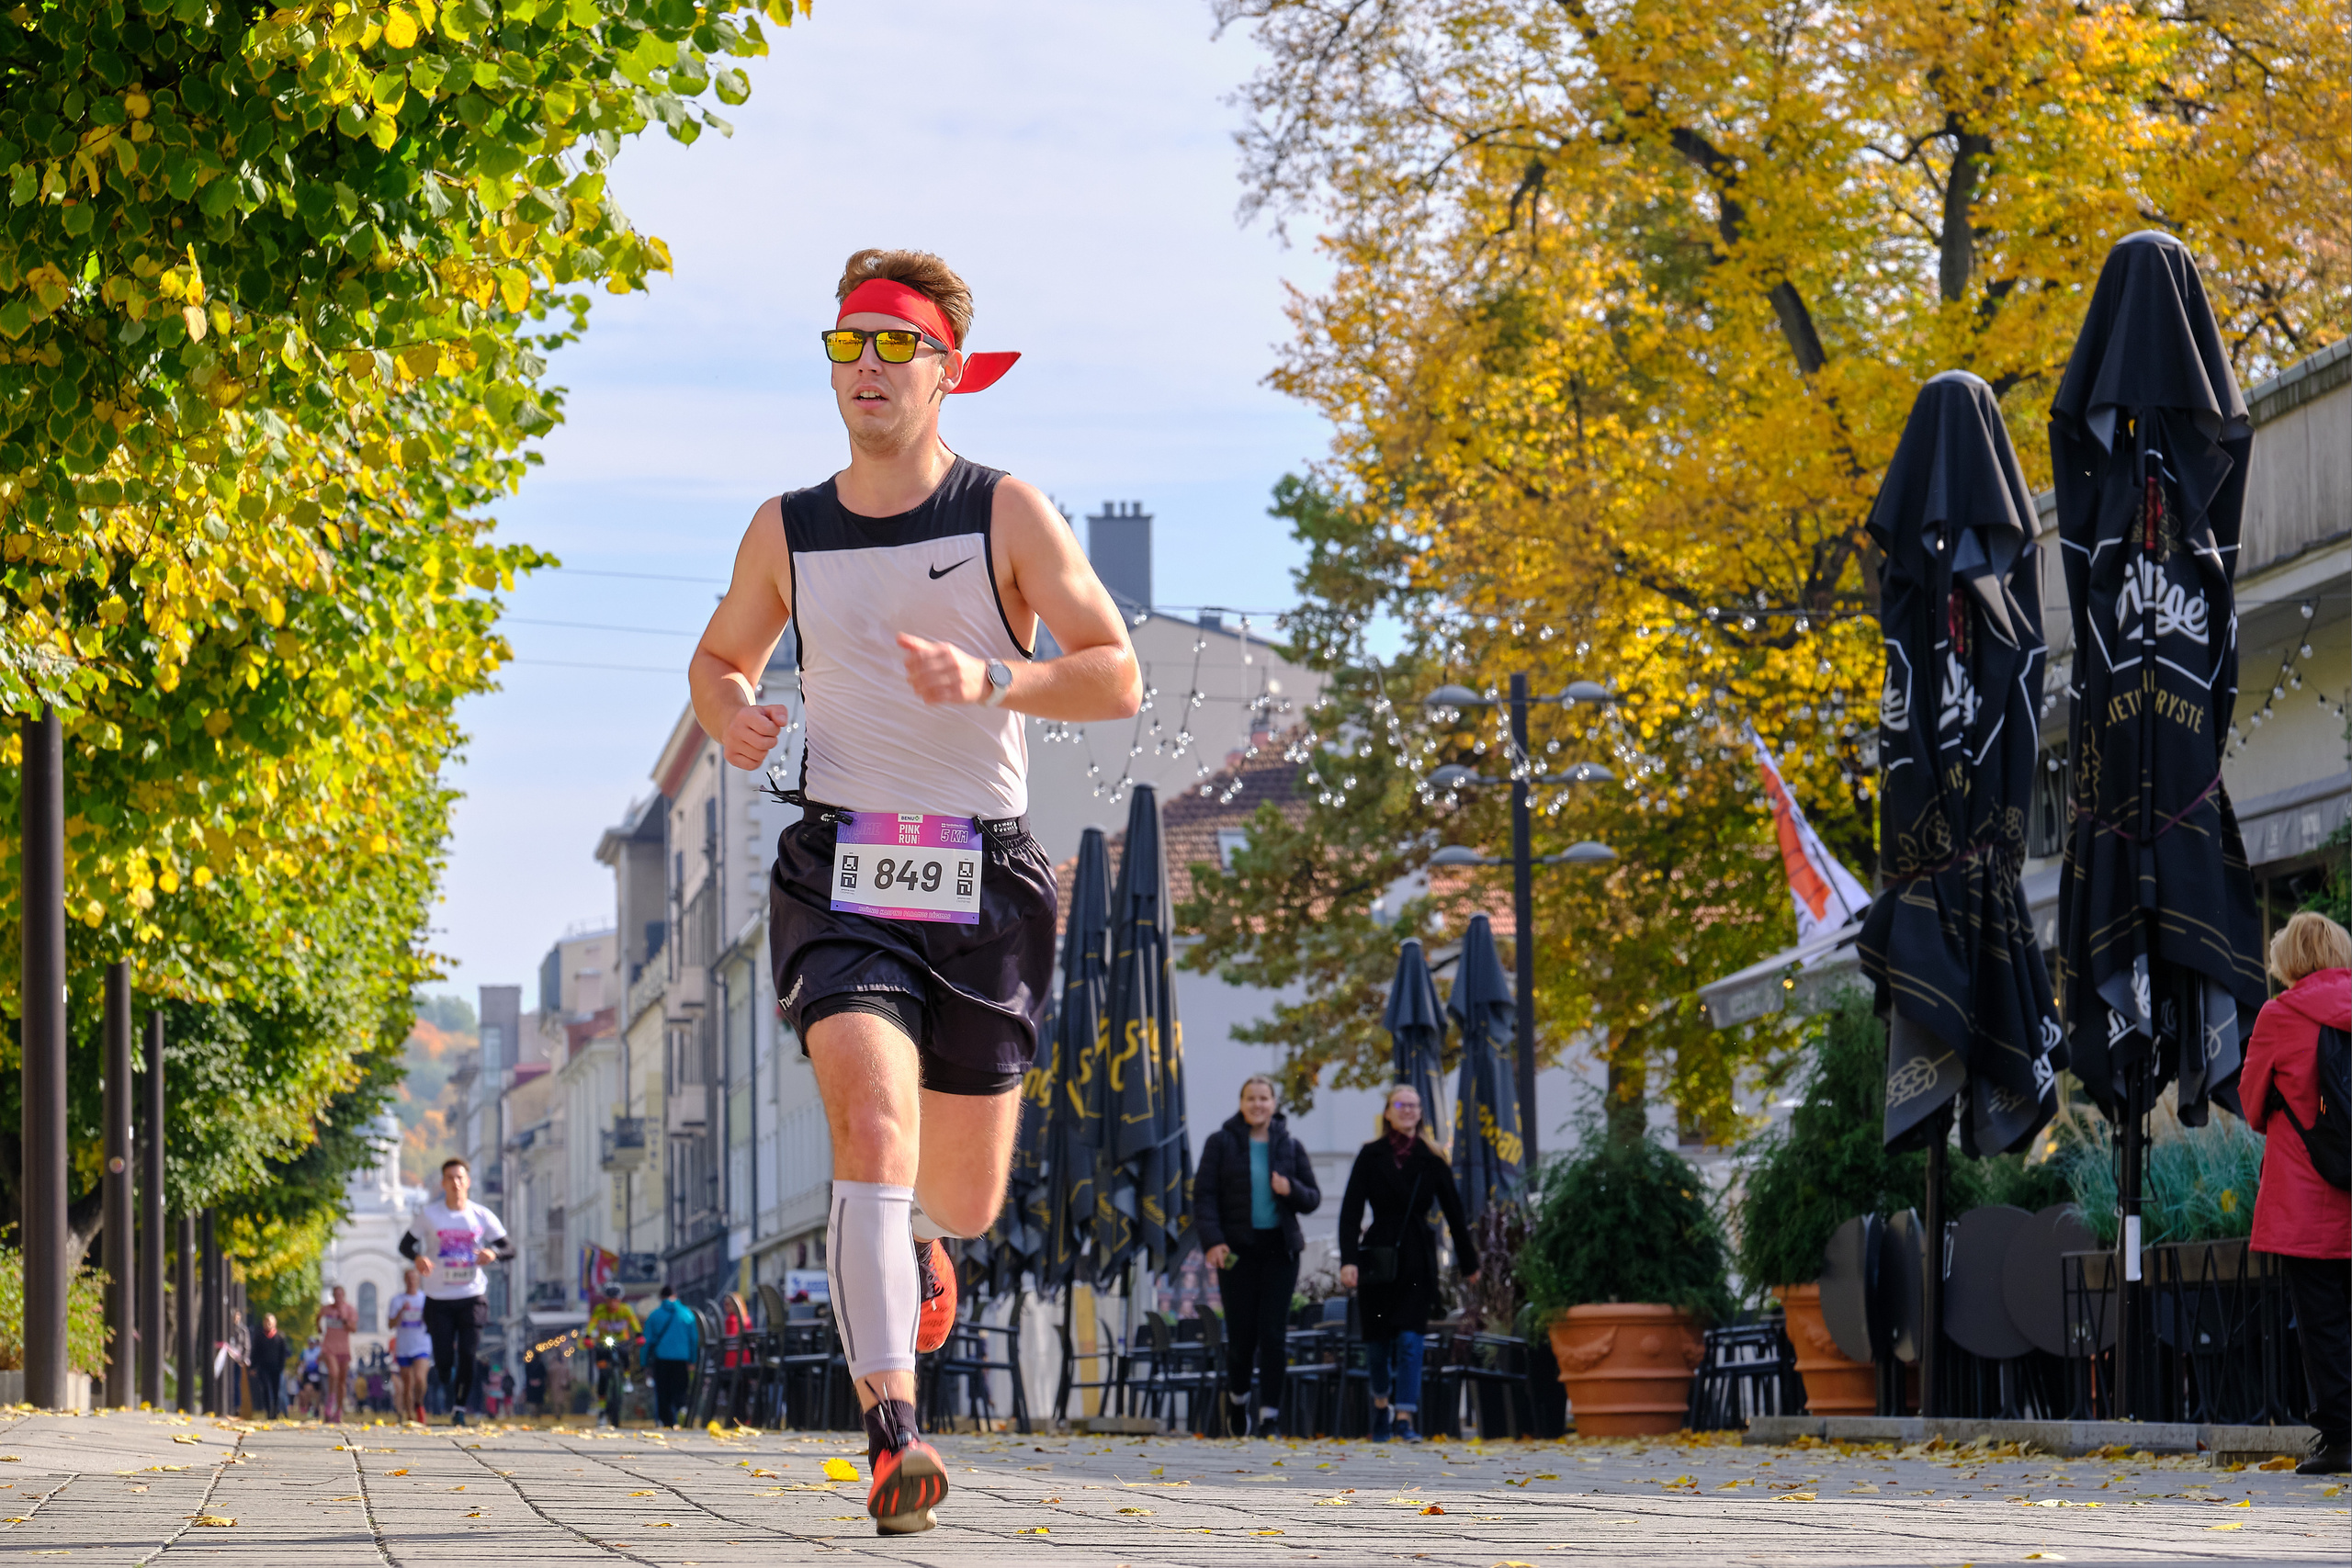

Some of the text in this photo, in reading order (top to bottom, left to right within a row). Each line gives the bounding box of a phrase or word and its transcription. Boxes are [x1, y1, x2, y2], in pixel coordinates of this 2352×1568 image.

[899, 824, 920, 834] PINK
[899, 834, 917, 844] RUN
[940, 829, 969, 843] 5 KM
[874, 858, 943, 893] 849
